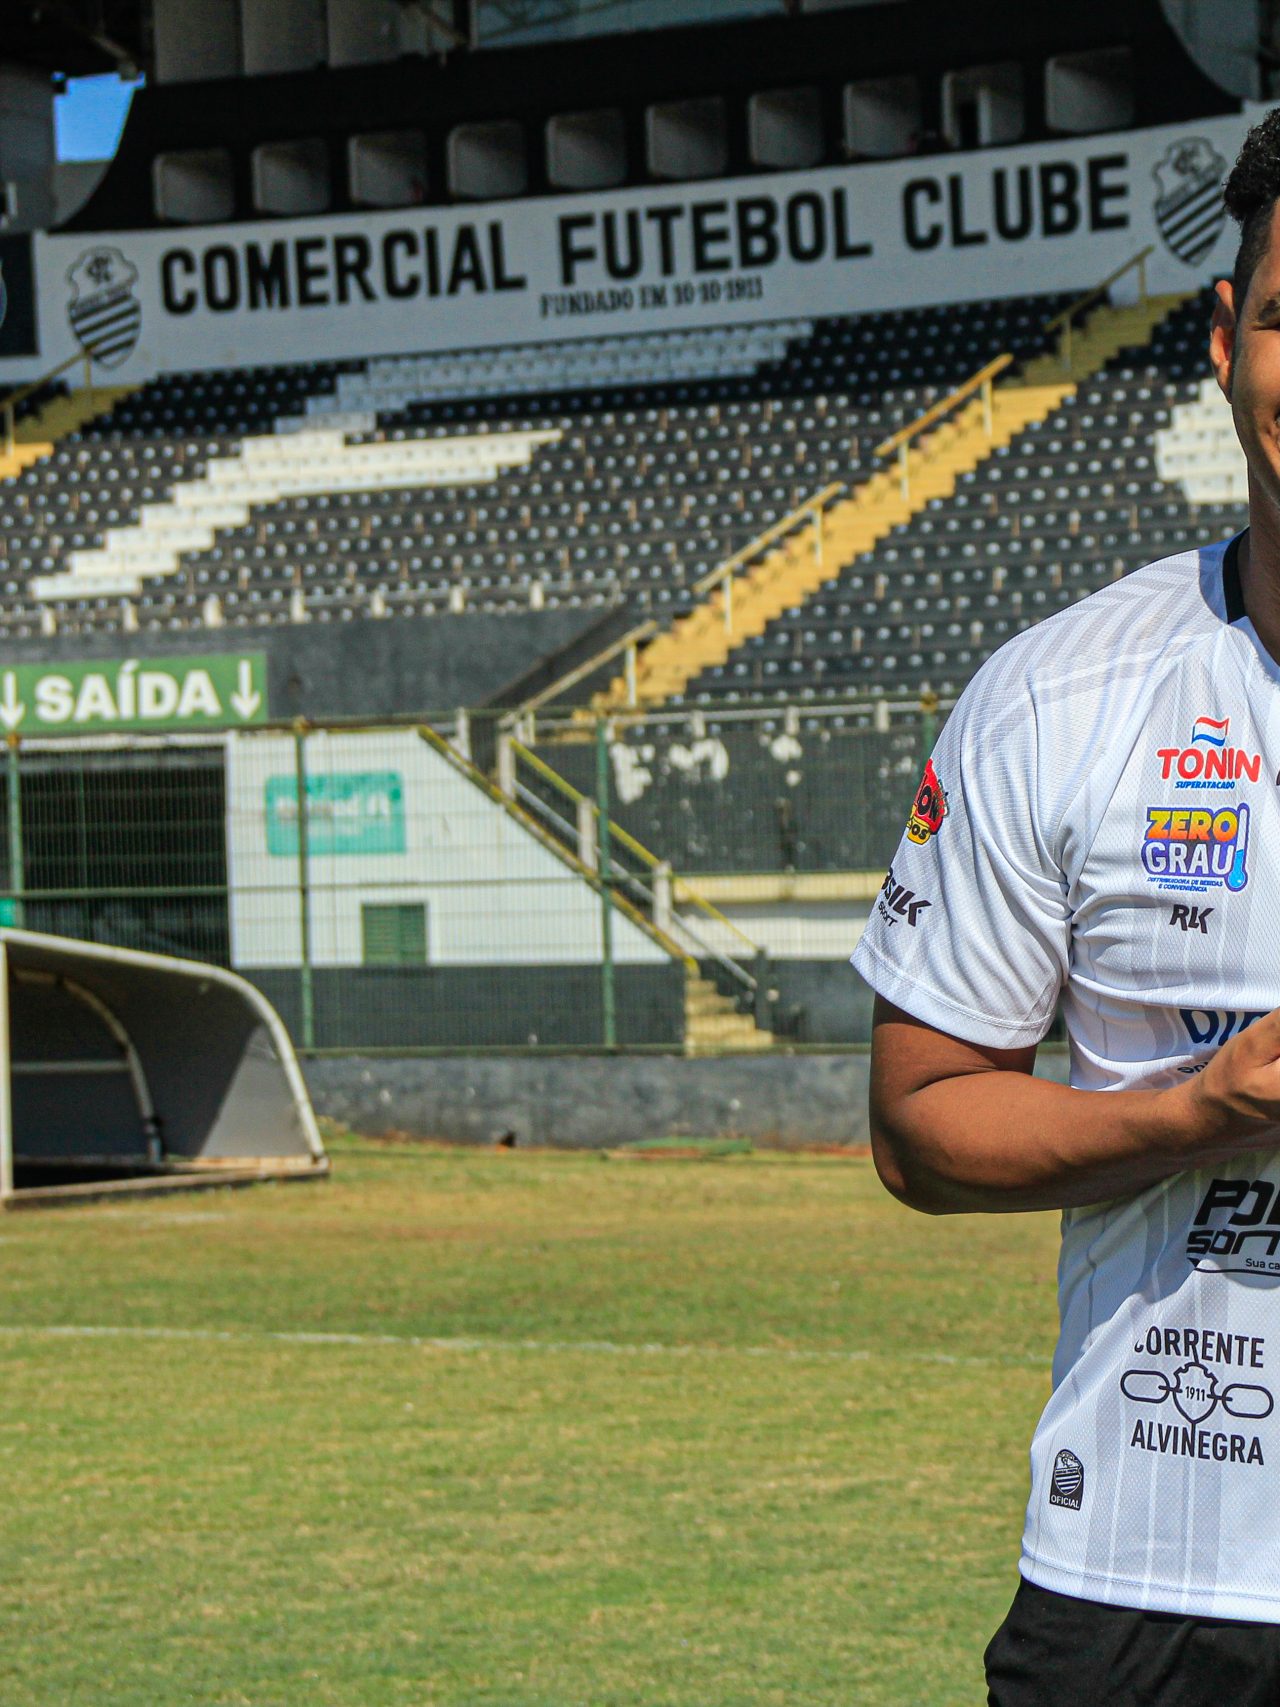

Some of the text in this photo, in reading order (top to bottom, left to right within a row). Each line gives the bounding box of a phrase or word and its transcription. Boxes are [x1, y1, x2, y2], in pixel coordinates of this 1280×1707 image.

[161, 220, 526, 315] COMERCIAL
[558, 187, 872, 286] FUTEBOL
[903, 153, 1129, 252] CLUBE
[540, 287, 634, 319] FUNDADO
[640, 284, 667, 310] EM
[34, 659, 223, 722] SAÍDA
[1157, 748, 1261, 782] TONIN
[1175, 781, 1236, 789] SUPERATACADO
[1147, 811, 1238, 842] ZERO
[1145, 842, 1235, 875] GRAU
[1245, 1258, 1266, 1268] Sua
[1185, 1386, 1205, 1401] 1911
[1131, 1419, 1264, 1466] ALVINEGRA
[1051, 1494, 1080, 1509] OFICIAL
